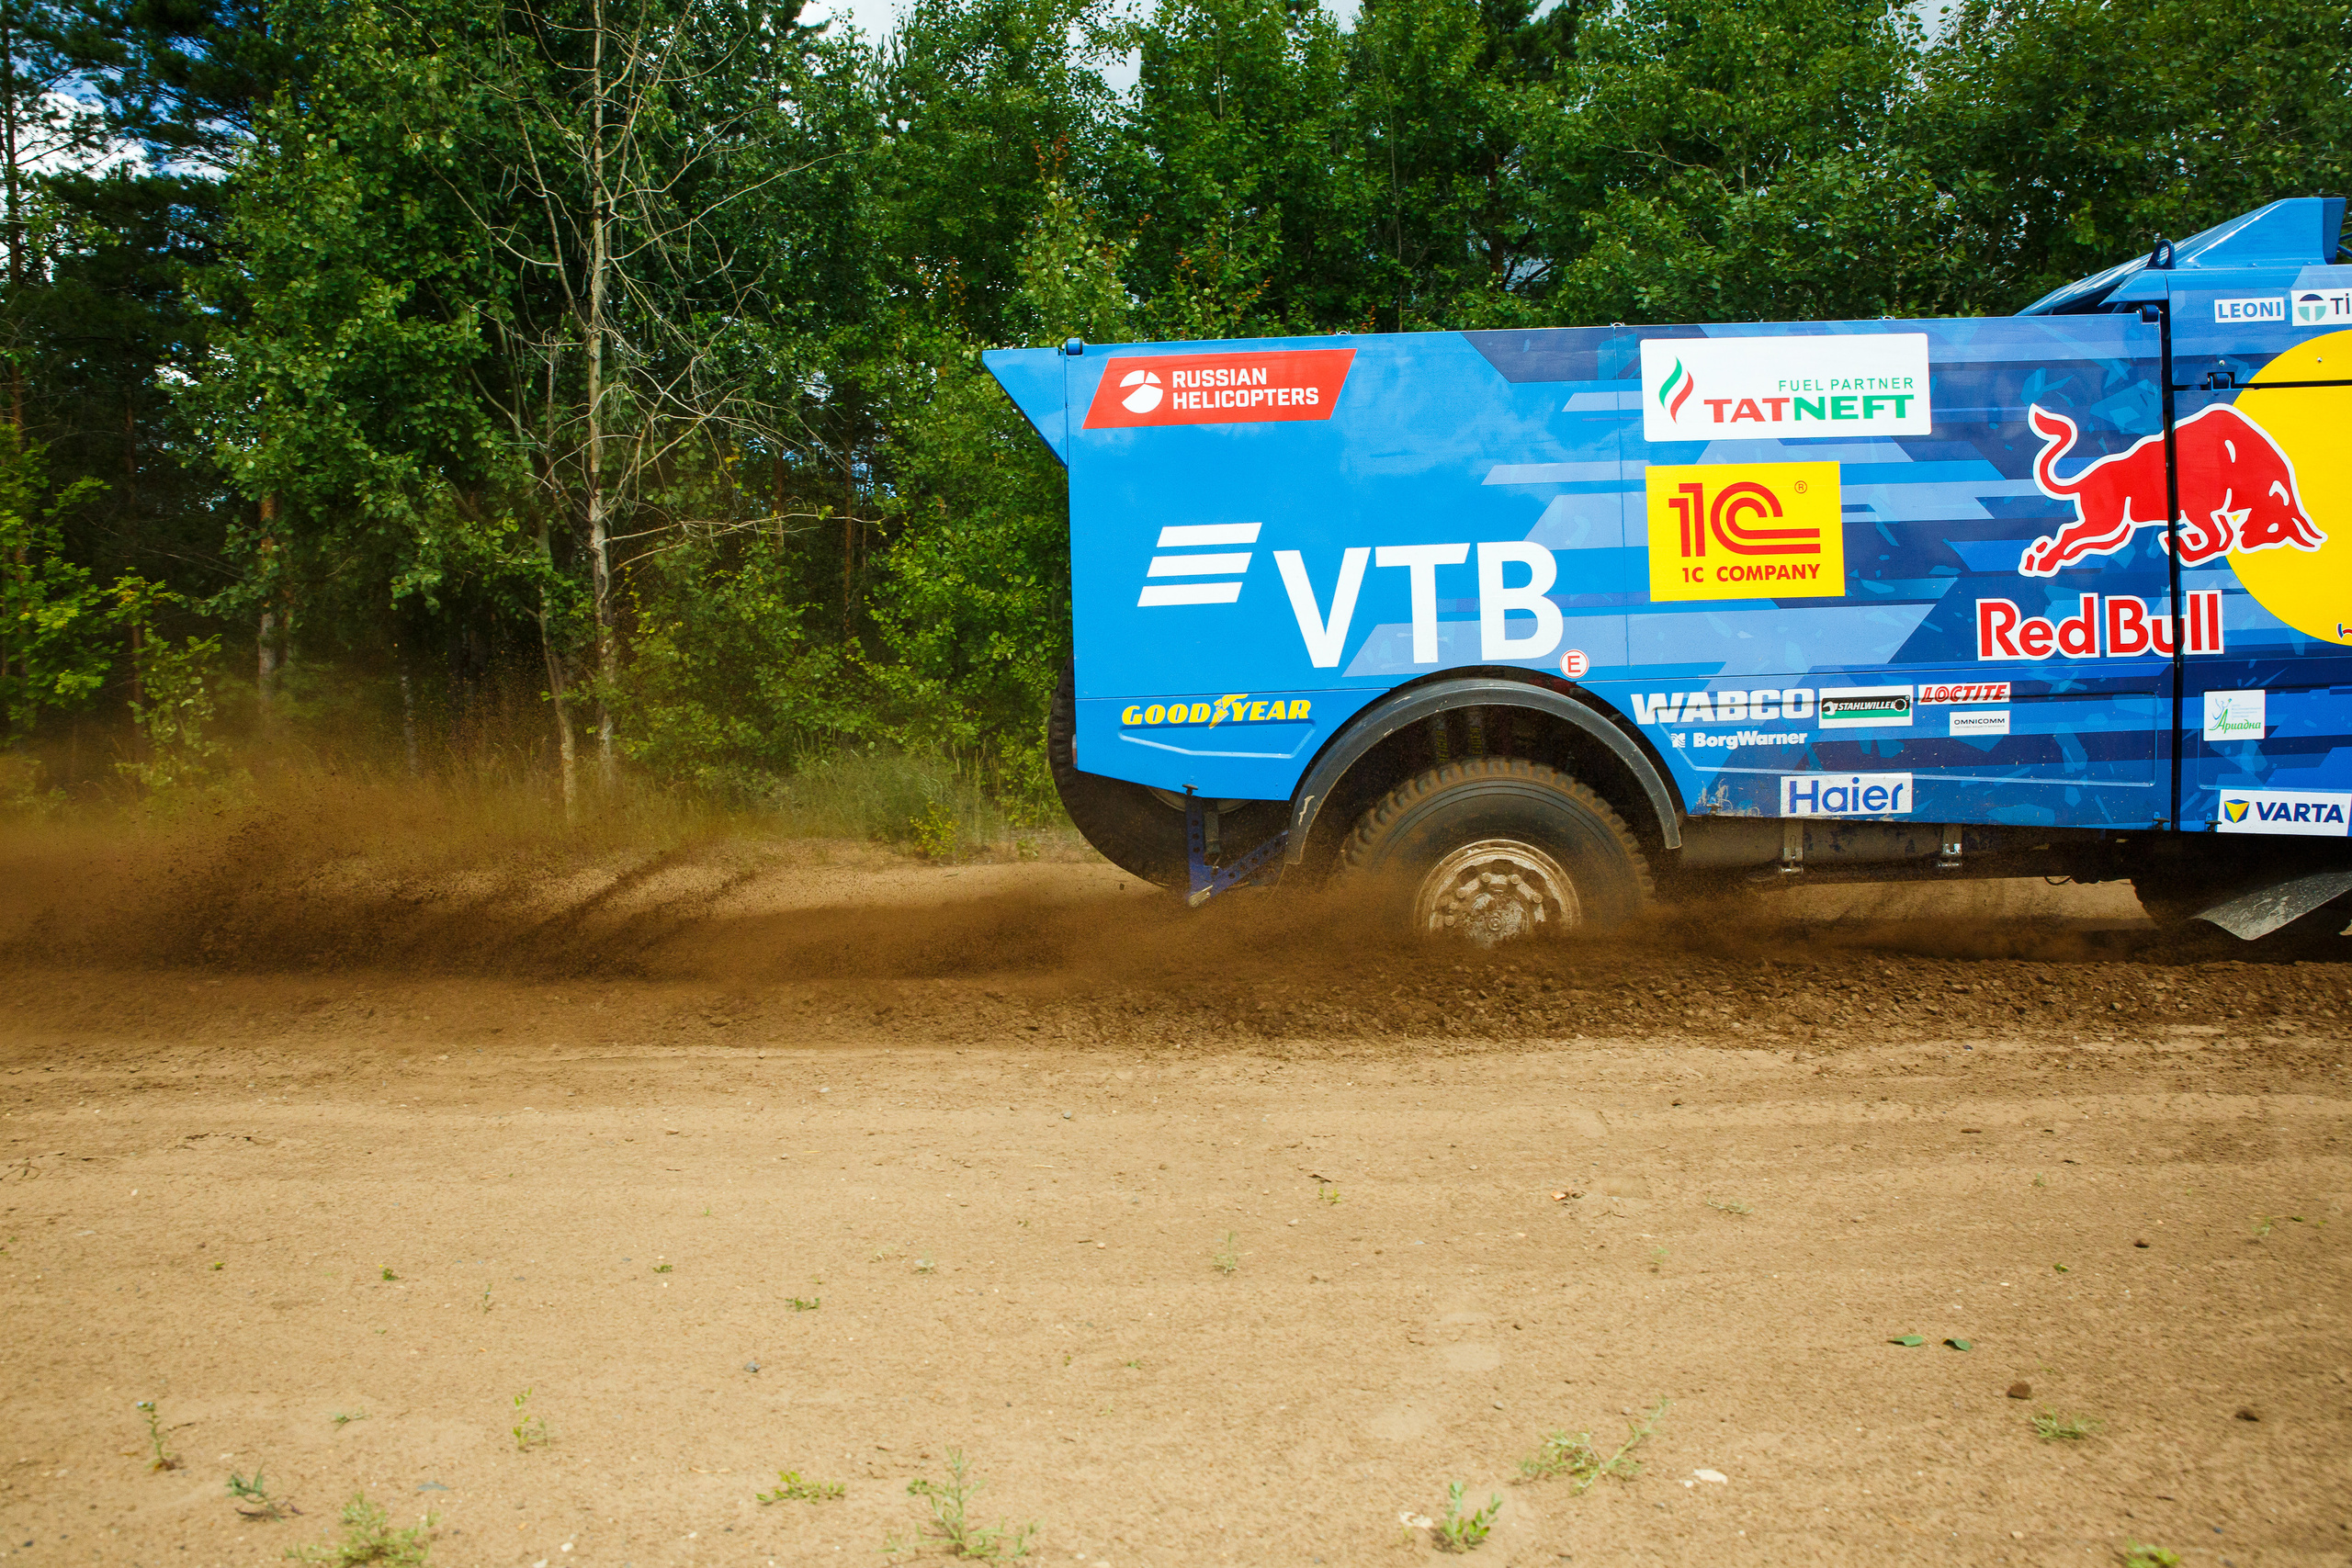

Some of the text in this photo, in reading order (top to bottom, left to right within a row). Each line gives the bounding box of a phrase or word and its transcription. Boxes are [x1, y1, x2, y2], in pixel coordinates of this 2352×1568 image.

[2218, 302, 2281, 320] LEONI
[1173, 367, 1266, 388] RUSSIAN
[1779, 378, 1914, 391] FUEL PARTNER
[1173, 387, 1319, 410] HELICOPTERS
[1703, 395, 1914, 423] TATNEFT
[1682, 564, 1821, 583] 1C COMPANY
[1272, 542, 1563, 668] VTB
[1976, 590, 2223, 660] Red Bull
[1921, 684, 2007, 704] LOCTITE
[1630, 688, 1815, 725] WABCO
[1838, 701, 1892, 711] STAHLWILLE
[2208, 708, 2261, 734] Ариадна
[1693, 731, 1808, 750] BorgWarner
[1789, 777, 1904, 813] Haier
[2256, 801, 2344, 823] VARTA
